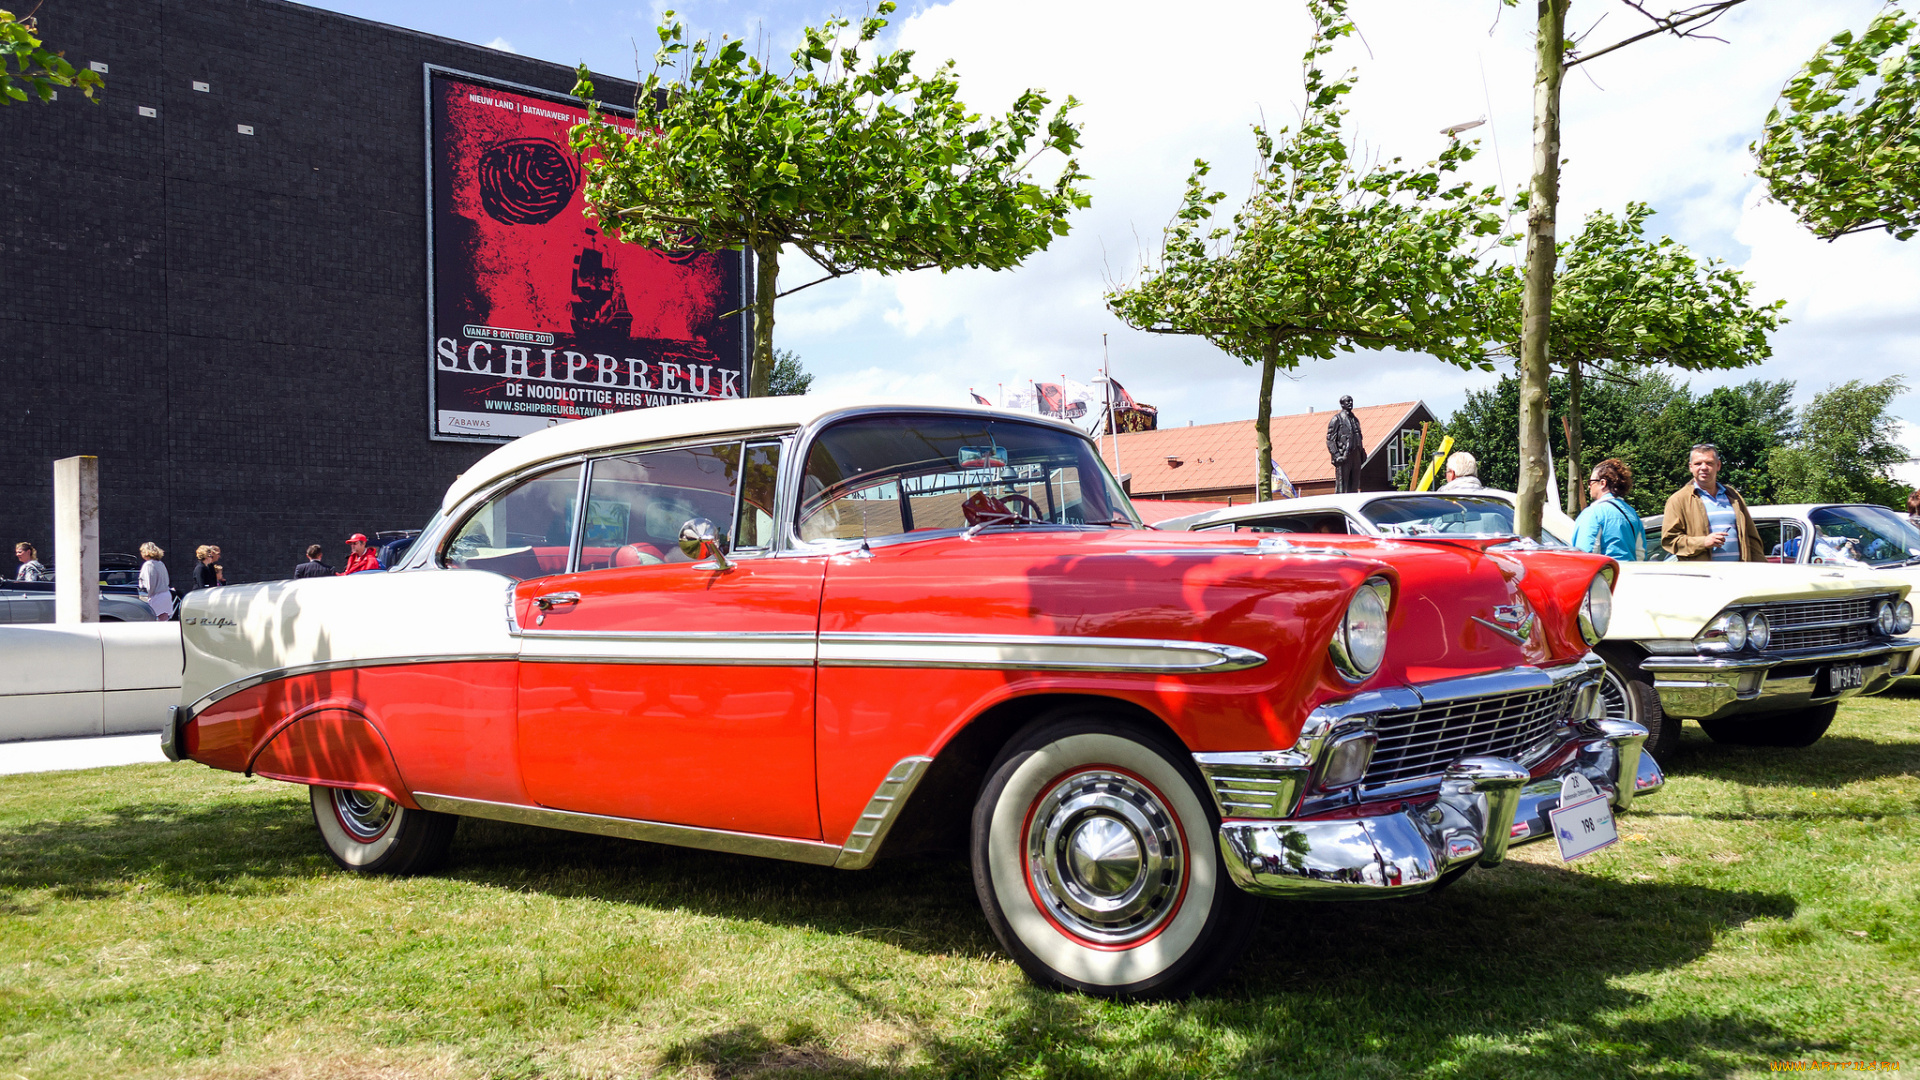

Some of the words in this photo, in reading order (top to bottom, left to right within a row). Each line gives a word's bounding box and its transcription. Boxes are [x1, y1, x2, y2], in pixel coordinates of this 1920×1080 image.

[469, 94, 493, 106] NIEUW
[494, 99, 514, 110] LAND
[523, 105, 570, 122] BATAVIAWERF
[466, 327, 491, 338] VANAF
[493, 329, 498, 338] 8
[500, 330, 534, 341] OKTOBER
[536, 333, 552, 343] 2011
[437, 337, 740, 399] SCHIPBREUK
[506, 383, 523, 397] DE
[527, 384, 612, 404] NOODLOTTIGE
[615, 392, 642, 407] REIS
[645, 394, 667, 407] VAN
[485, 400, 614, 418] WWW.SCHIPBREUKBATAVIAN
[448, 417, 490, 428] ZABAWAS
[1581, 817, 1596, 834] 198
